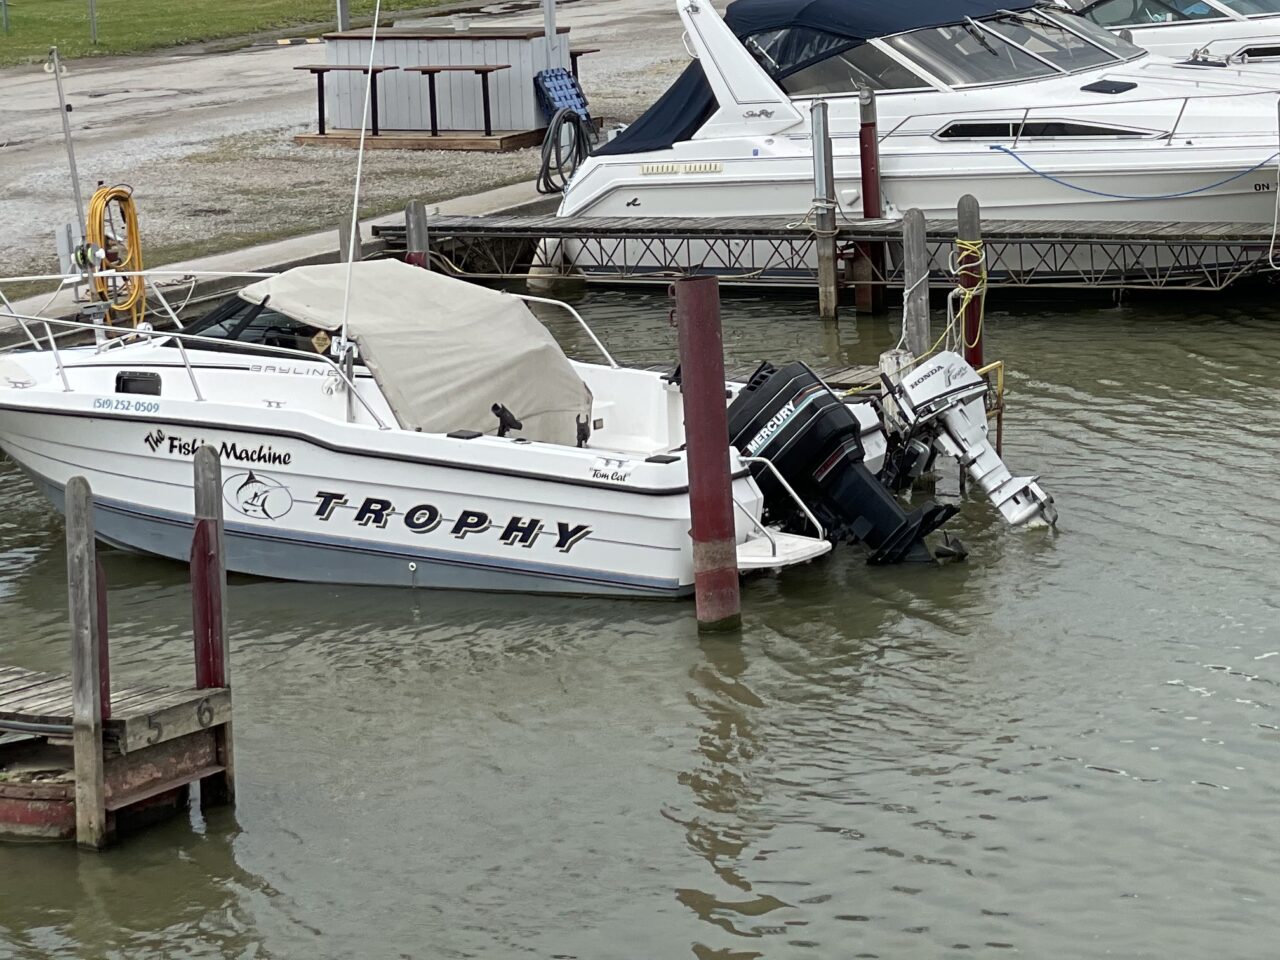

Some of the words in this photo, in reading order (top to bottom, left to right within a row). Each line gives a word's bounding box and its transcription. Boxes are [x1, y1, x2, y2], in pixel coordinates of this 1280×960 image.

[254, 183, 270, 192] ON
[250, 364, 341, 377] BAYLINE
[910, 365, 945, 390] HONDA
[746, 399, 797, 454] MERCURY
[144, 429, 166, 452] The
[218, 441, 291, 465] Machine
[315, 491, 594, 554] TROPHY
[147, 712, 163, 745] 5
[197, 695, 214, 728] 6
